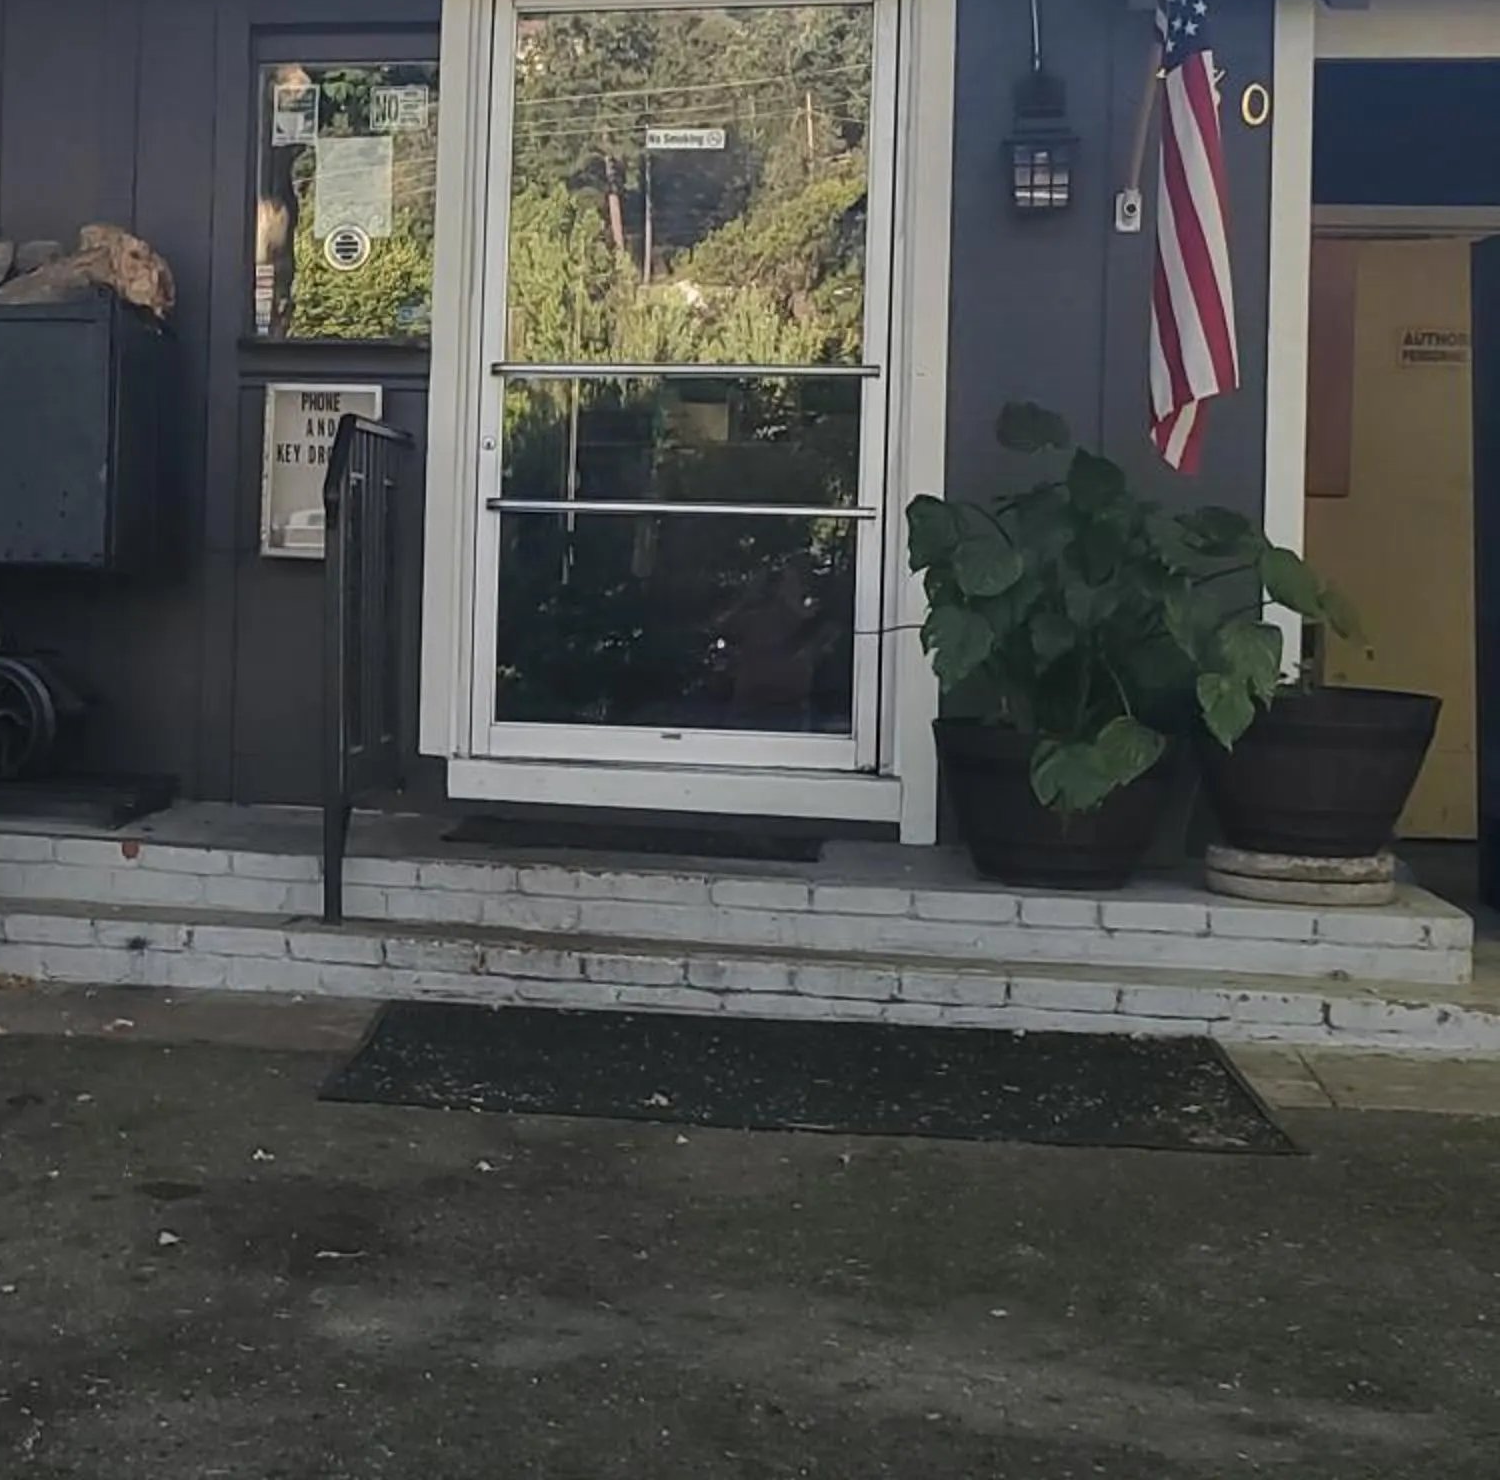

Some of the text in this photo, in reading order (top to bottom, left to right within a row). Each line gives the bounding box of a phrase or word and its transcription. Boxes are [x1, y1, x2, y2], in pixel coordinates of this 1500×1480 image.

[301, 391, 341, 412] PHONE
[305, 418, 336, 437] AND
[276, 443, 301, 464] KEY
